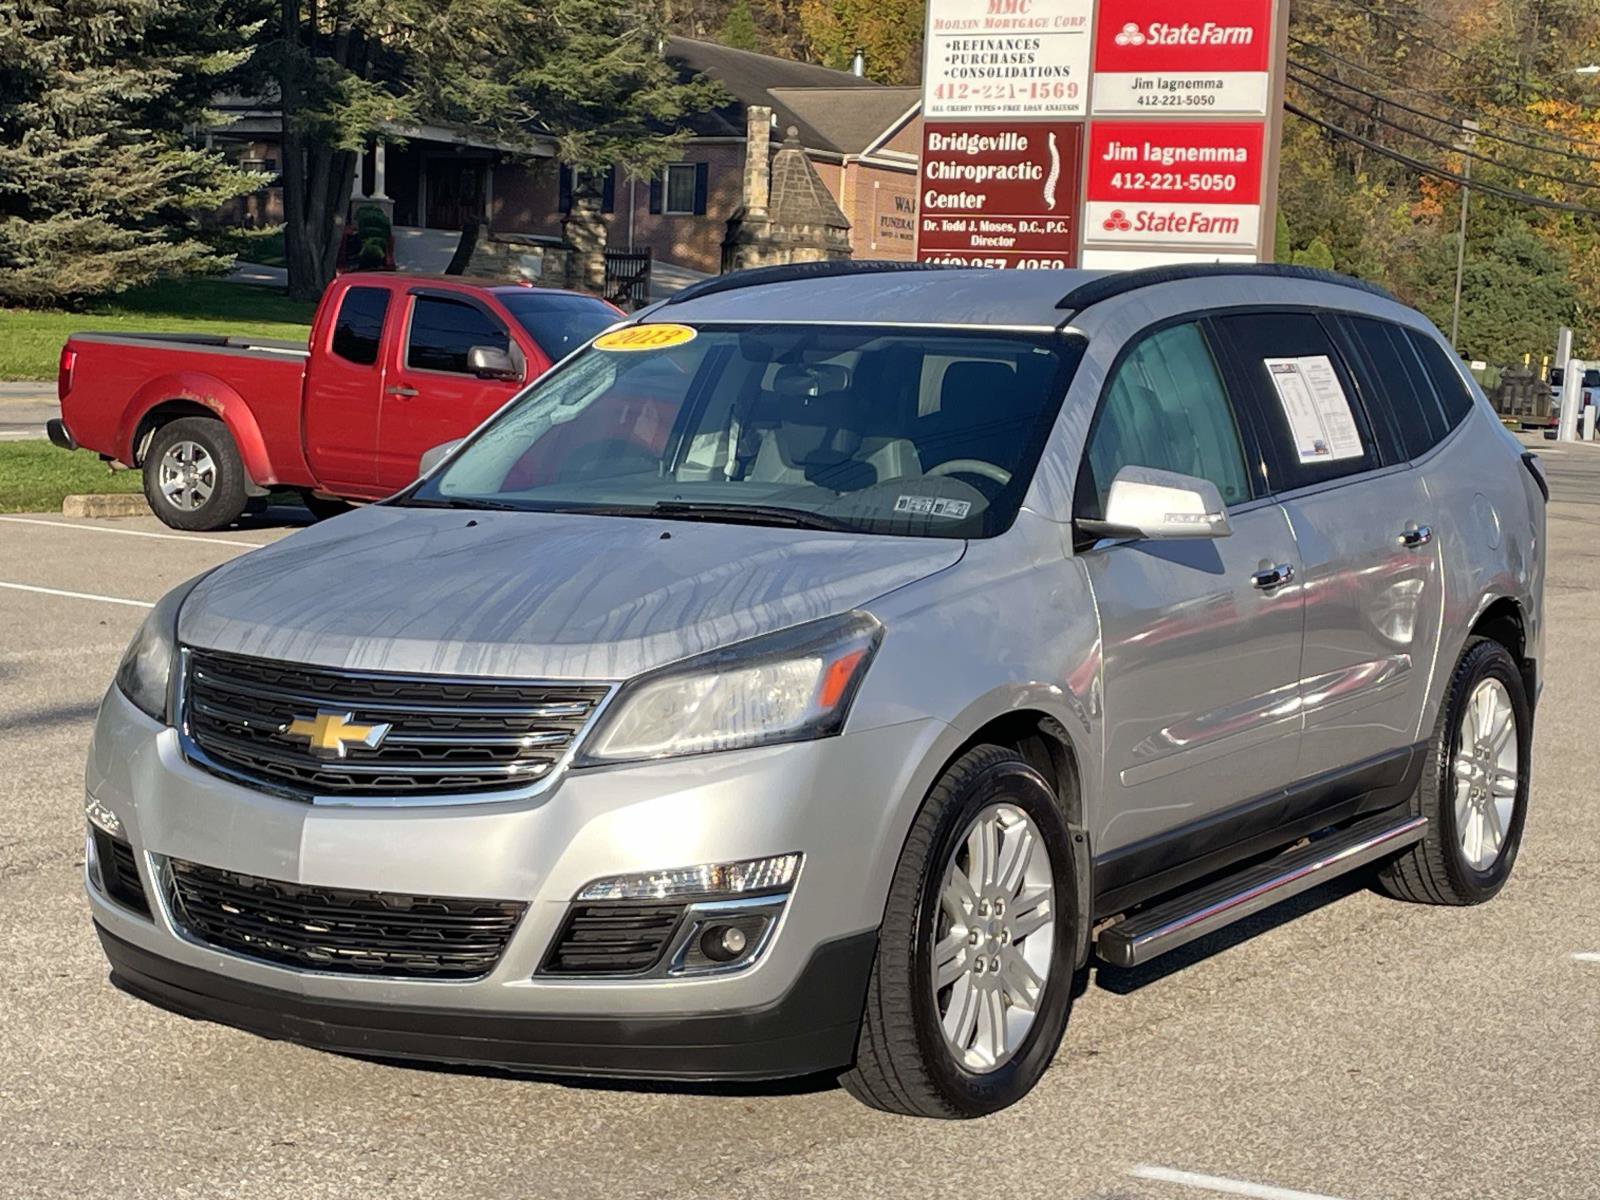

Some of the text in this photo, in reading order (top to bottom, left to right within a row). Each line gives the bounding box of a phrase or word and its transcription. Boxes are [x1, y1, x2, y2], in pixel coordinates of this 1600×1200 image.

[987, 0, 1032, 14] MMC
[984, 17, 1049, 29] MORTGAGE
[952, 38, 1040, 51] REFINANCES
[951, 53, 1035, 65] PURCHASES
[951, 65, 1071, 79] CONSOLIDATIONS
[934, 82, 1079, 99] 412-221-1569
[1131, 77, 1153, 90] Jim
[1137, 95, 1215, 106] 412-221-5050
[928, 132, 1028, 155] Bridgeville
[1102, 142, 1248, 166] Jim Iagnemma
[926, 161, 1043, 183] Chiropractic
[1110, 172, 1236, 191] 412-221-5050
[924, 190, 986, 209] Center
[923, 219, 940, 231] Dr.
[942, 220, 966, 231] Todd
[968, 220, 978, 232] J.
[979, 221, 1016, 234] Moses,
[1046, 221, 1068, 233] P.C.
[970, 235, 1016, 247] Director
